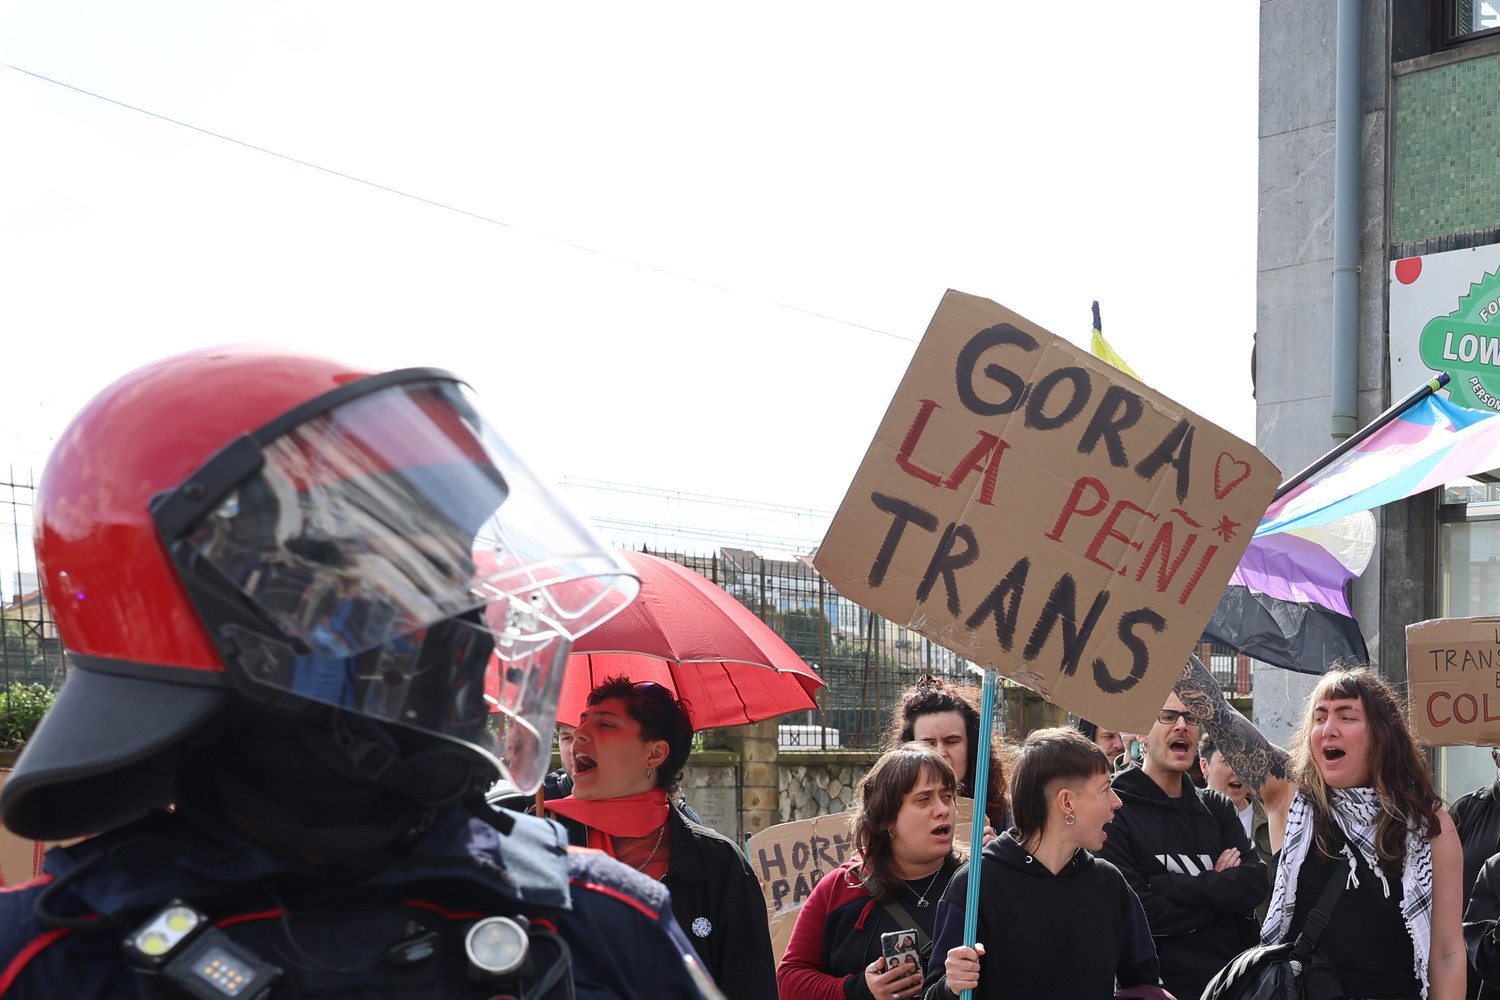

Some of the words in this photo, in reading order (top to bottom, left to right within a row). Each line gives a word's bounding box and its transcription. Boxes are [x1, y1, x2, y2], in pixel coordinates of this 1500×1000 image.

[895, 398, 1012, 507] LA
[955, 321, 1196, 506] GORA
[870, 491, 1169, 694] TRANS
[757, 831, 854, 882] HORM
